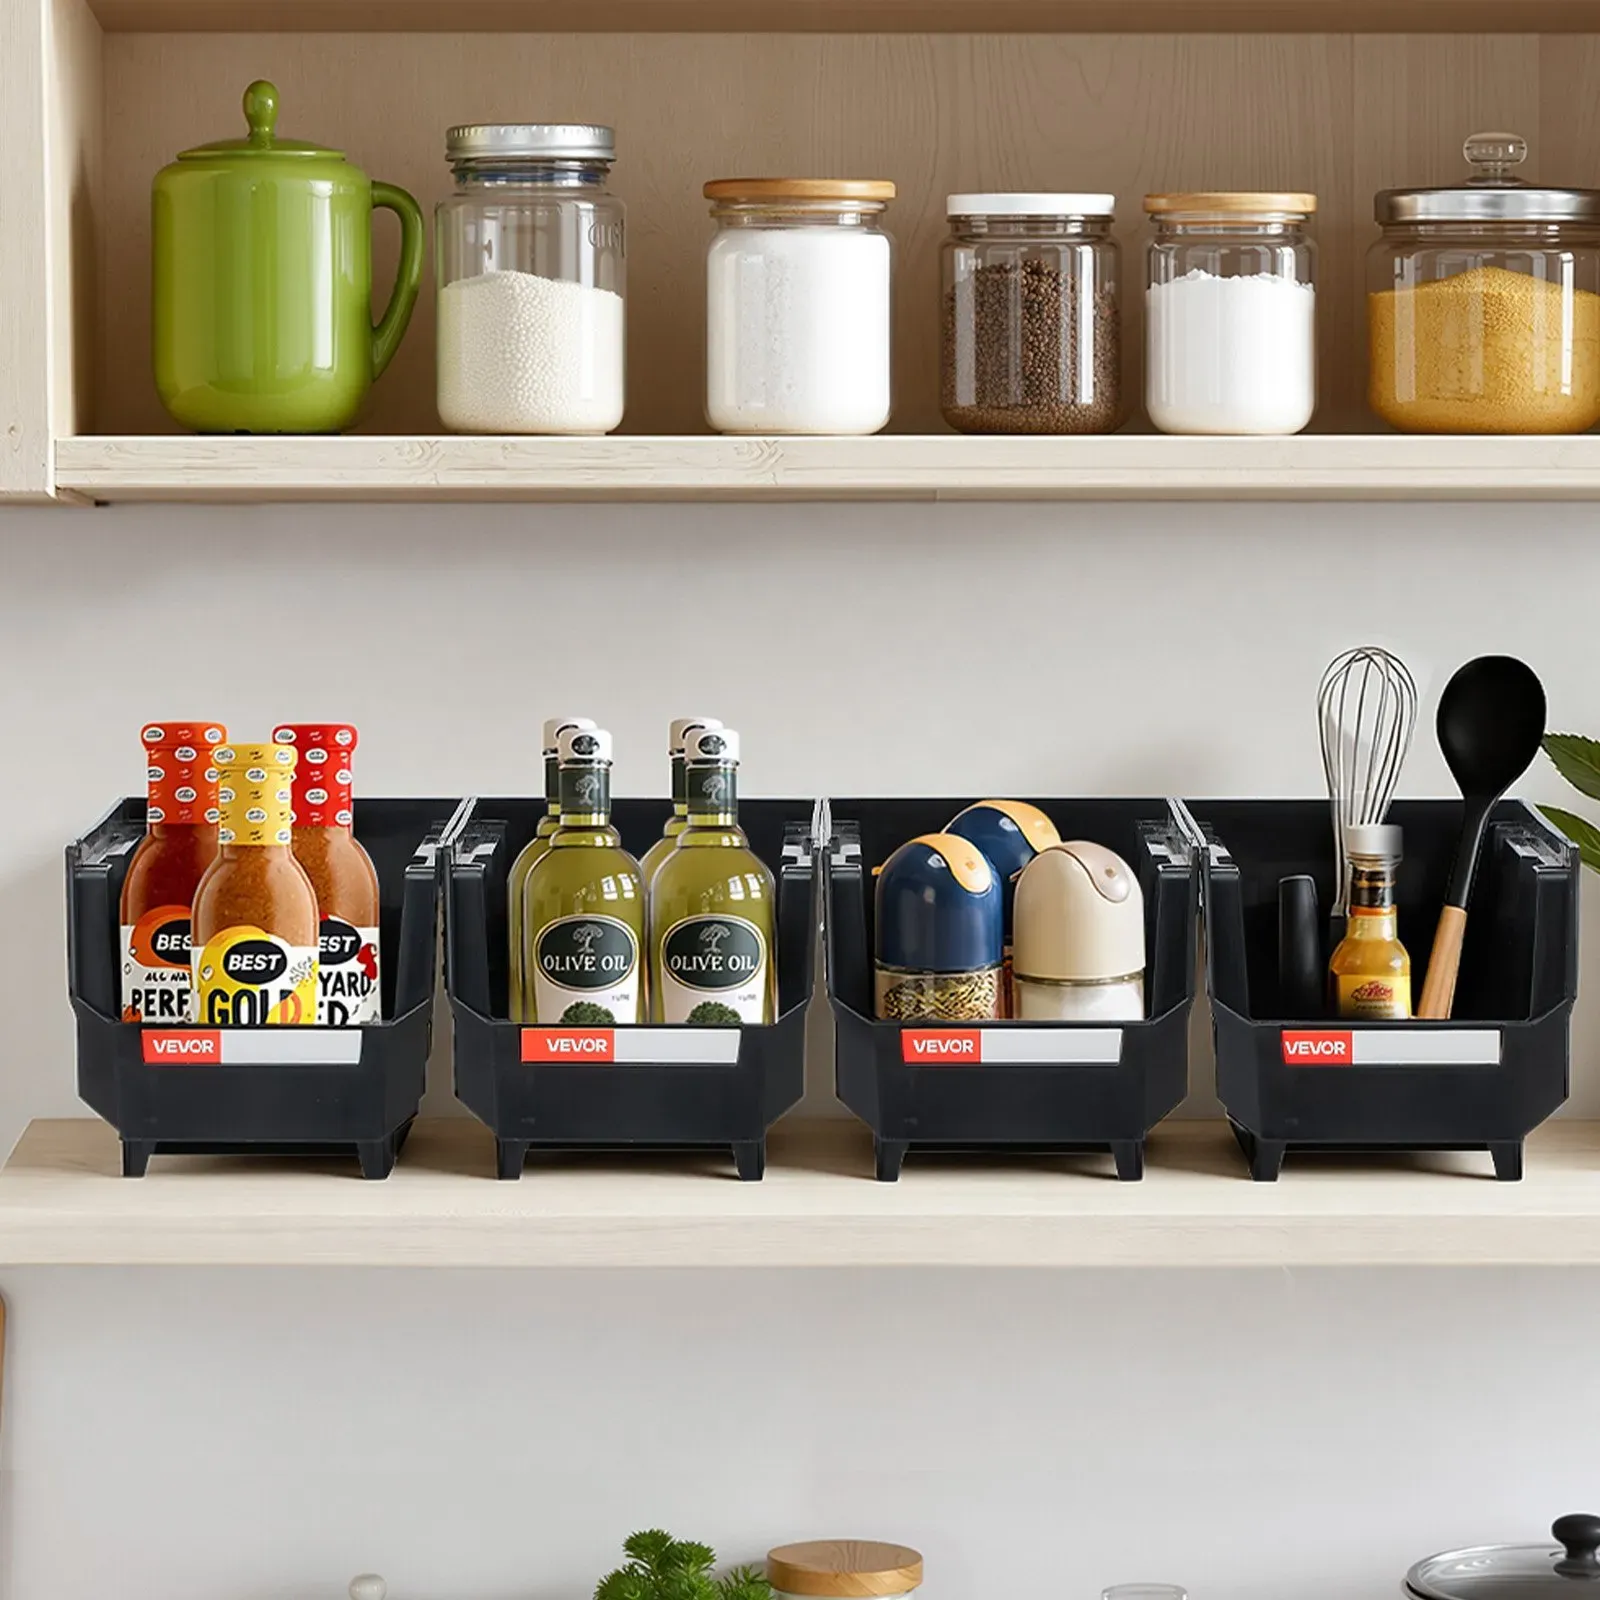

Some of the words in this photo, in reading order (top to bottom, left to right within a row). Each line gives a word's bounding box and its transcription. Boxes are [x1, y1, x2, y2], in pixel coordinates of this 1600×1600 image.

[228, 954, 282, 971] BEST
[543, 954, 597, 972] OLIVE
[601, 954, 628, 972] OIL
[670, 954, 724, 972] OLIVE
[727, 954, 755, 972] OIL
[152, 1039, 214, 1054] VEVOR
[546, 1038, 608, 1053] VEVOR
[912, 1039, 974, 1054] VEVOR
[1284, 1040, 1346, 1055] VEVOR
